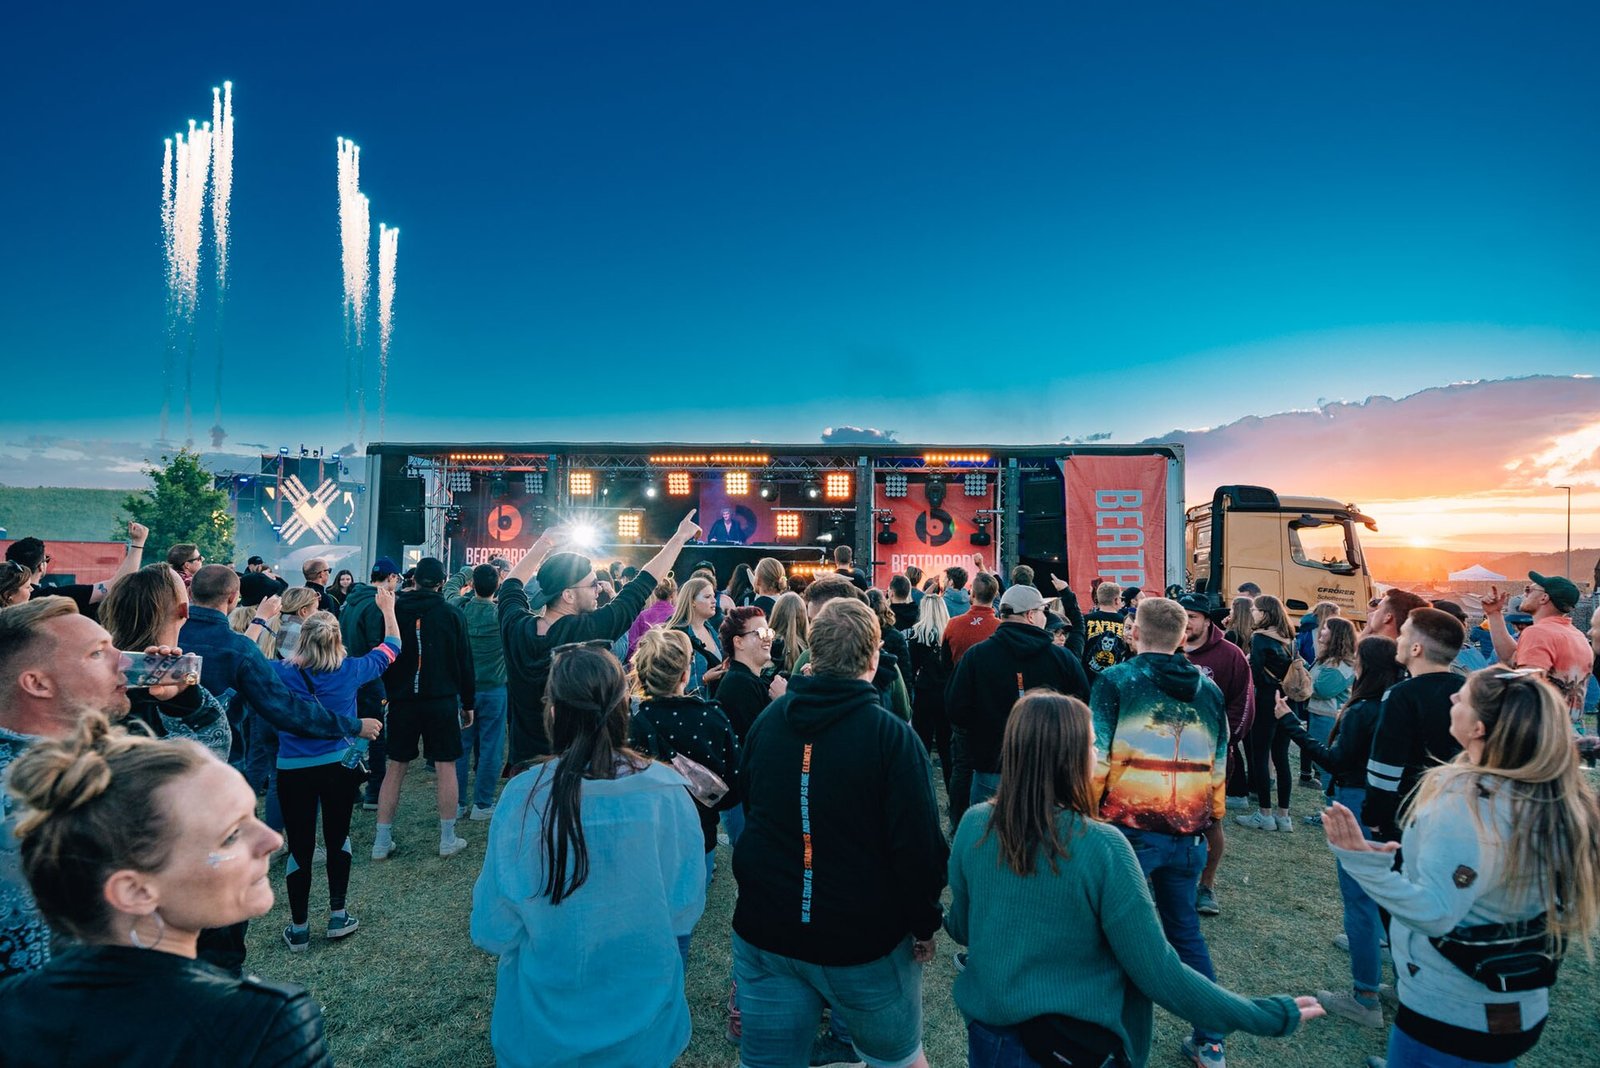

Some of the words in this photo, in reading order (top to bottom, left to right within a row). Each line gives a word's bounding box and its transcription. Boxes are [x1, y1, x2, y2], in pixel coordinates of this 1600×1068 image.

[891, 554, 977, 573] BEATPARAD
[801, 773, 809, 787] ONE
[800, 787, 808, 797] AS
[801, 796, 808, 805] UP
[801, 806, 809, 819] END
[802, 820, 811, 833] AND
[804, 869, 813, 880] AS
[802, 878, 812, 899] START
[801, 899, 811, 911] ALL
[801, 911, 810, 923] WE
